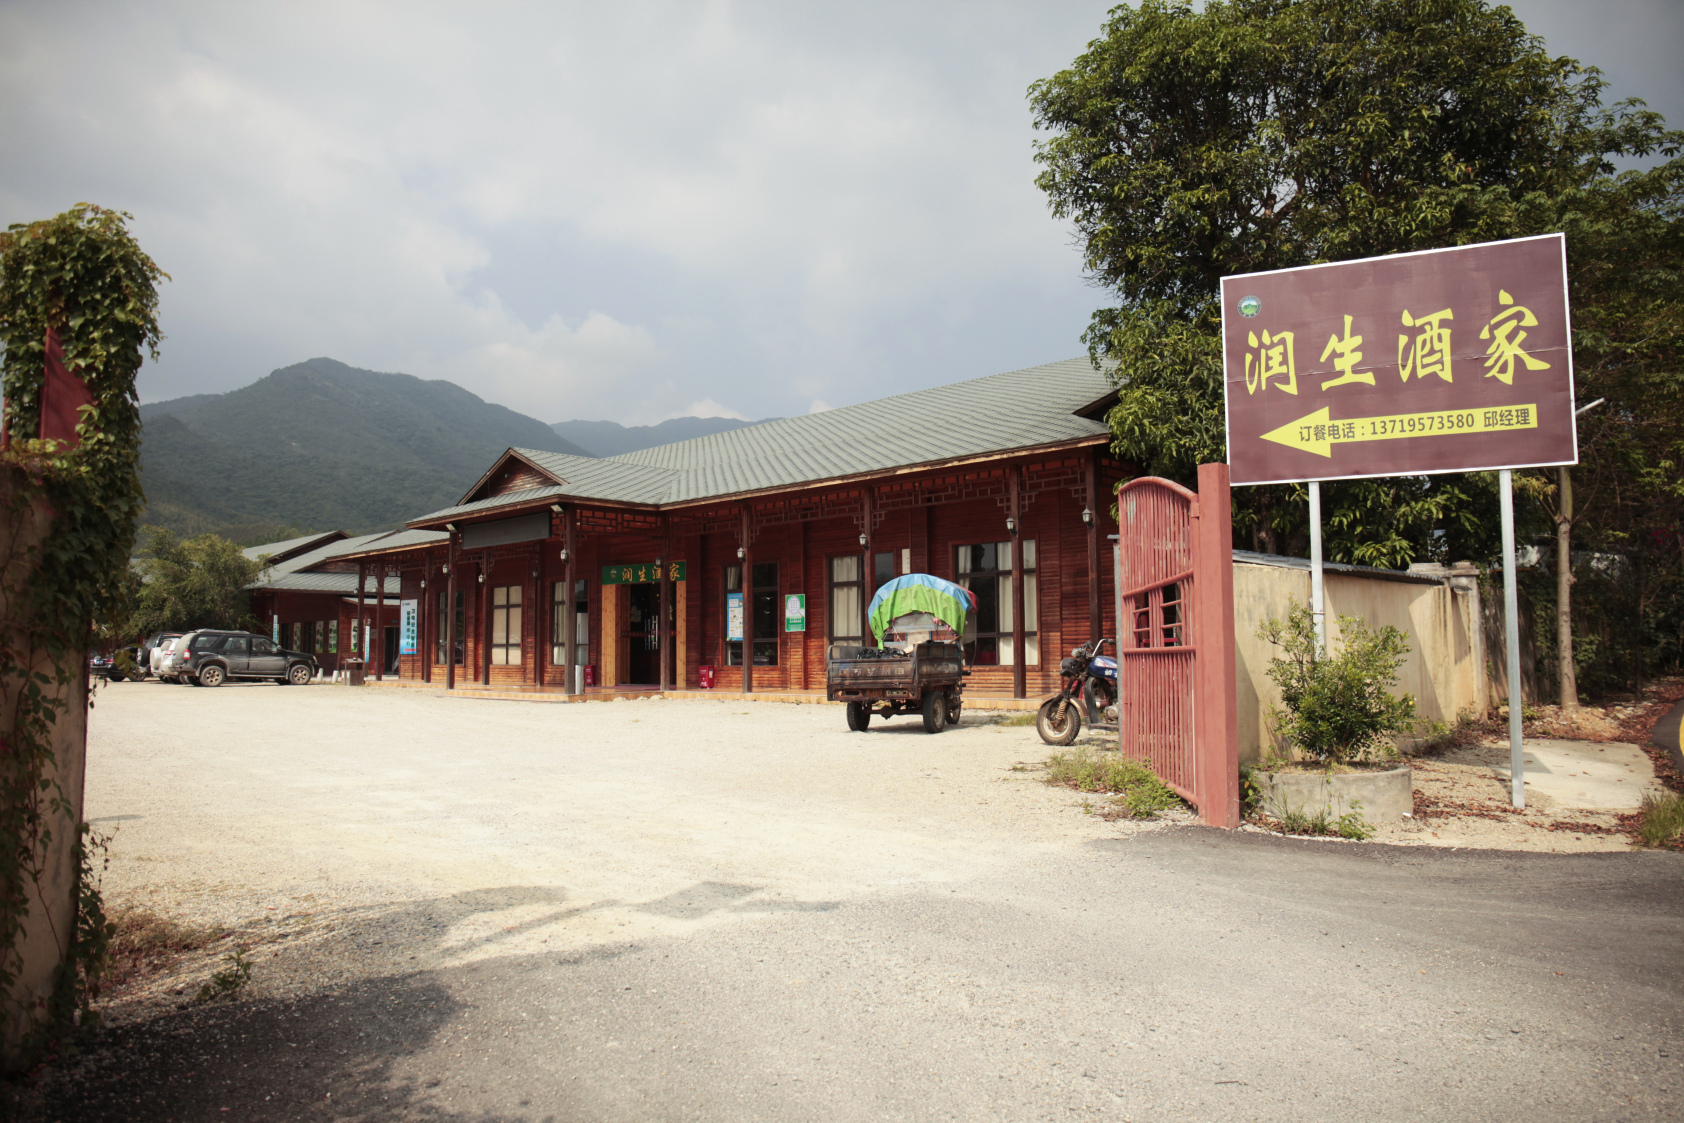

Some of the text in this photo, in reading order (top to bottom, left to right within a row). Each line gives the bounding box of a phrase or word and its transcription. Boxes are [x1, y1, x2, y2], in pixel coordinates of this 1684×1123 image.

[1244, 289, 1551, 395] 润生酒家
[1484, 408, 1531, 428] 邱经理
